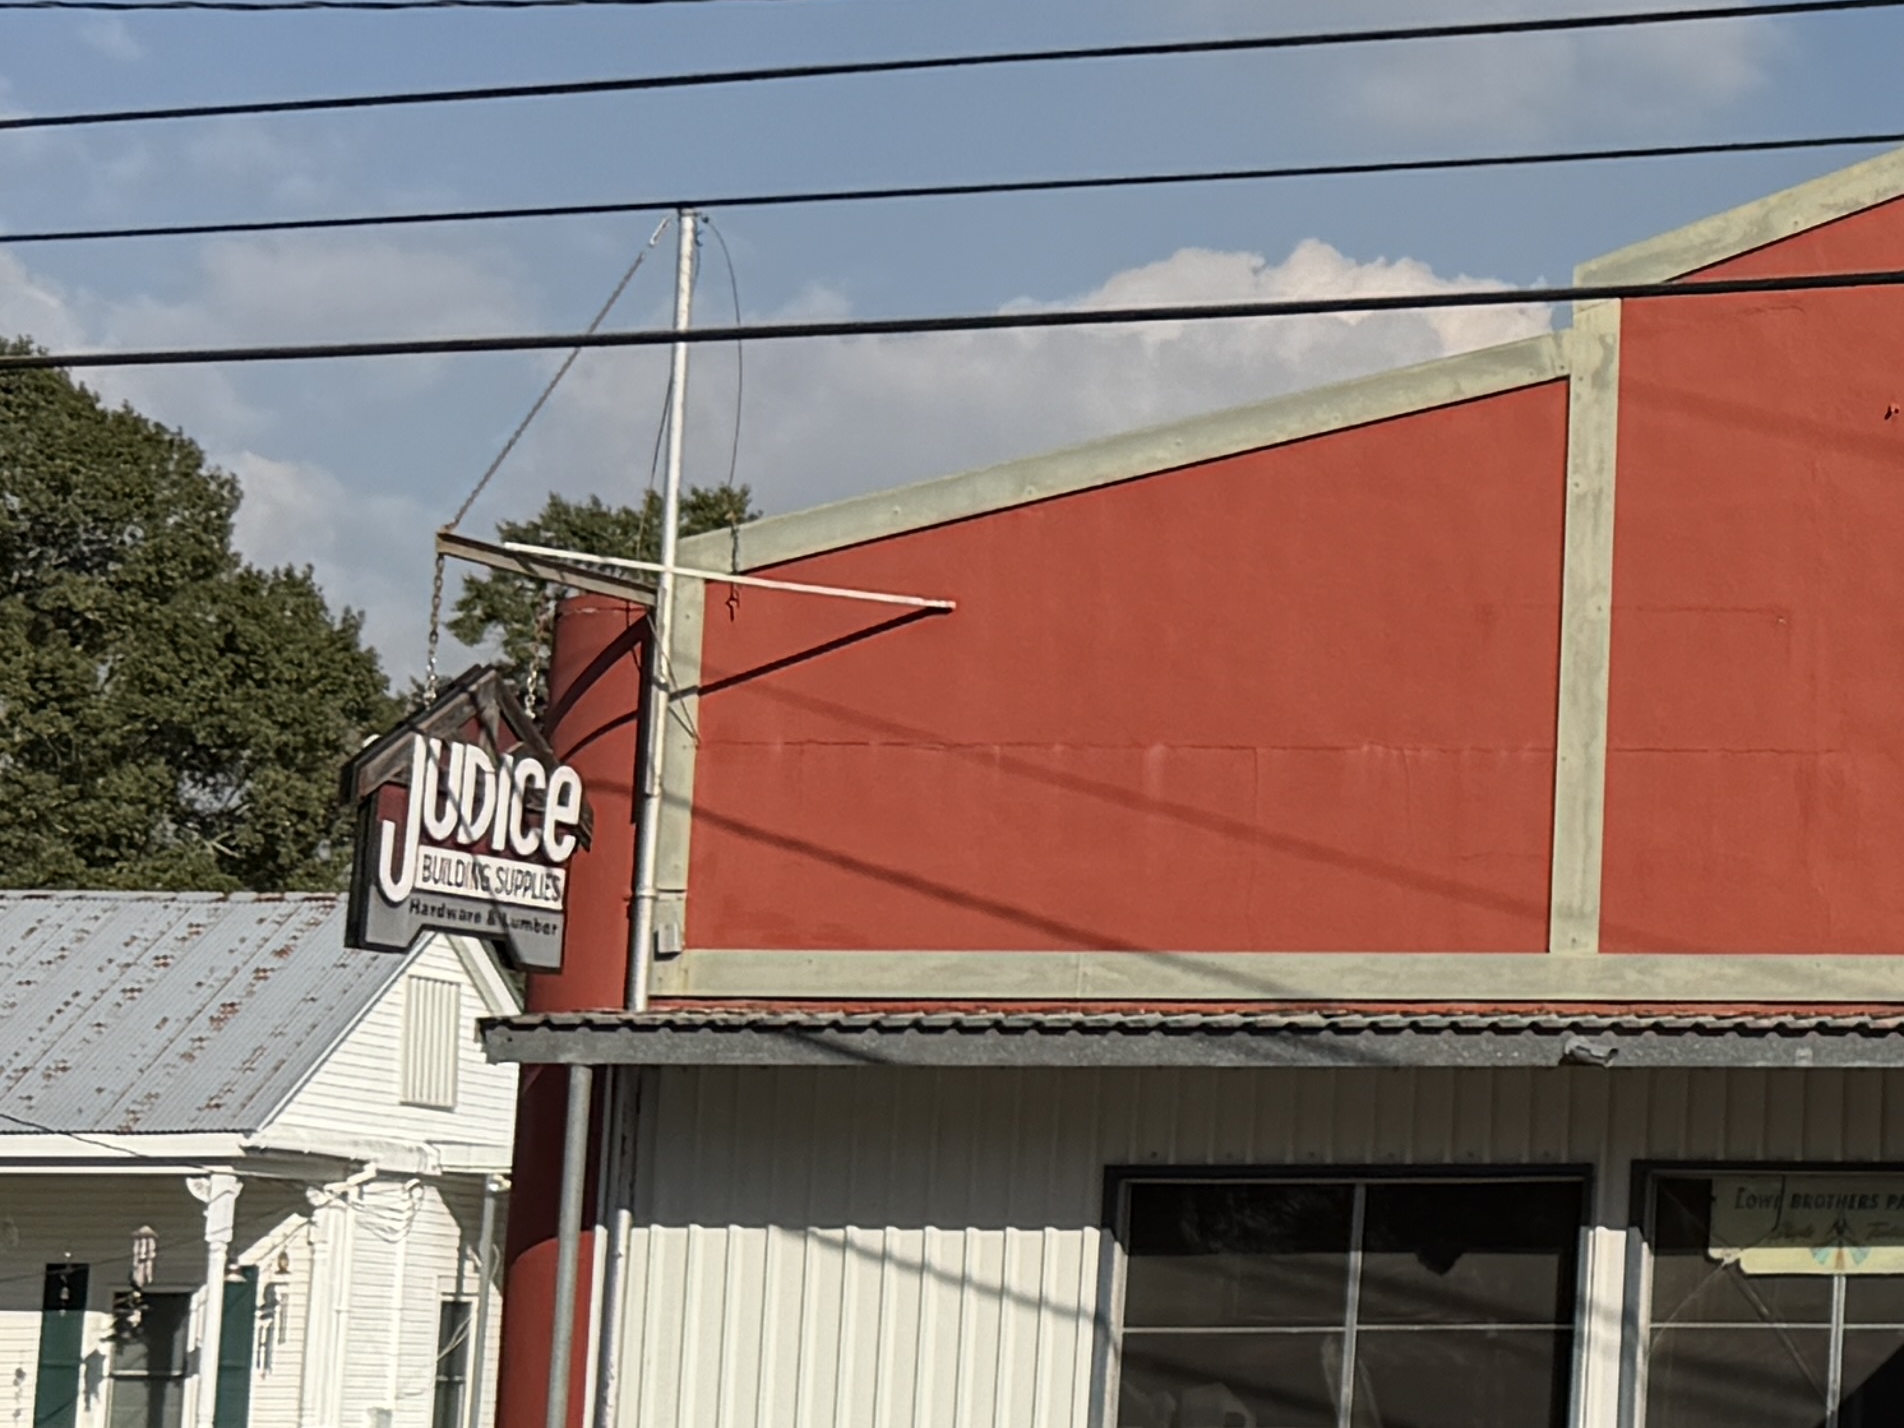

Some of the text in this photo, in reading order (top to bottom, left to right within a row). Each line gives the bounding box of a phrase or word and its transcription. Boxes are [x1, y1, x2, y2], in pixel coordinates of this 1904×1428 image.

[422, 854, 561, 903] BUILDING SUPPLIES
[409, 899, 483, 925] Hardware
[503, 914, 559, 936] Lumber
[1790, 1193, 1880, 1210] BROTHERS
